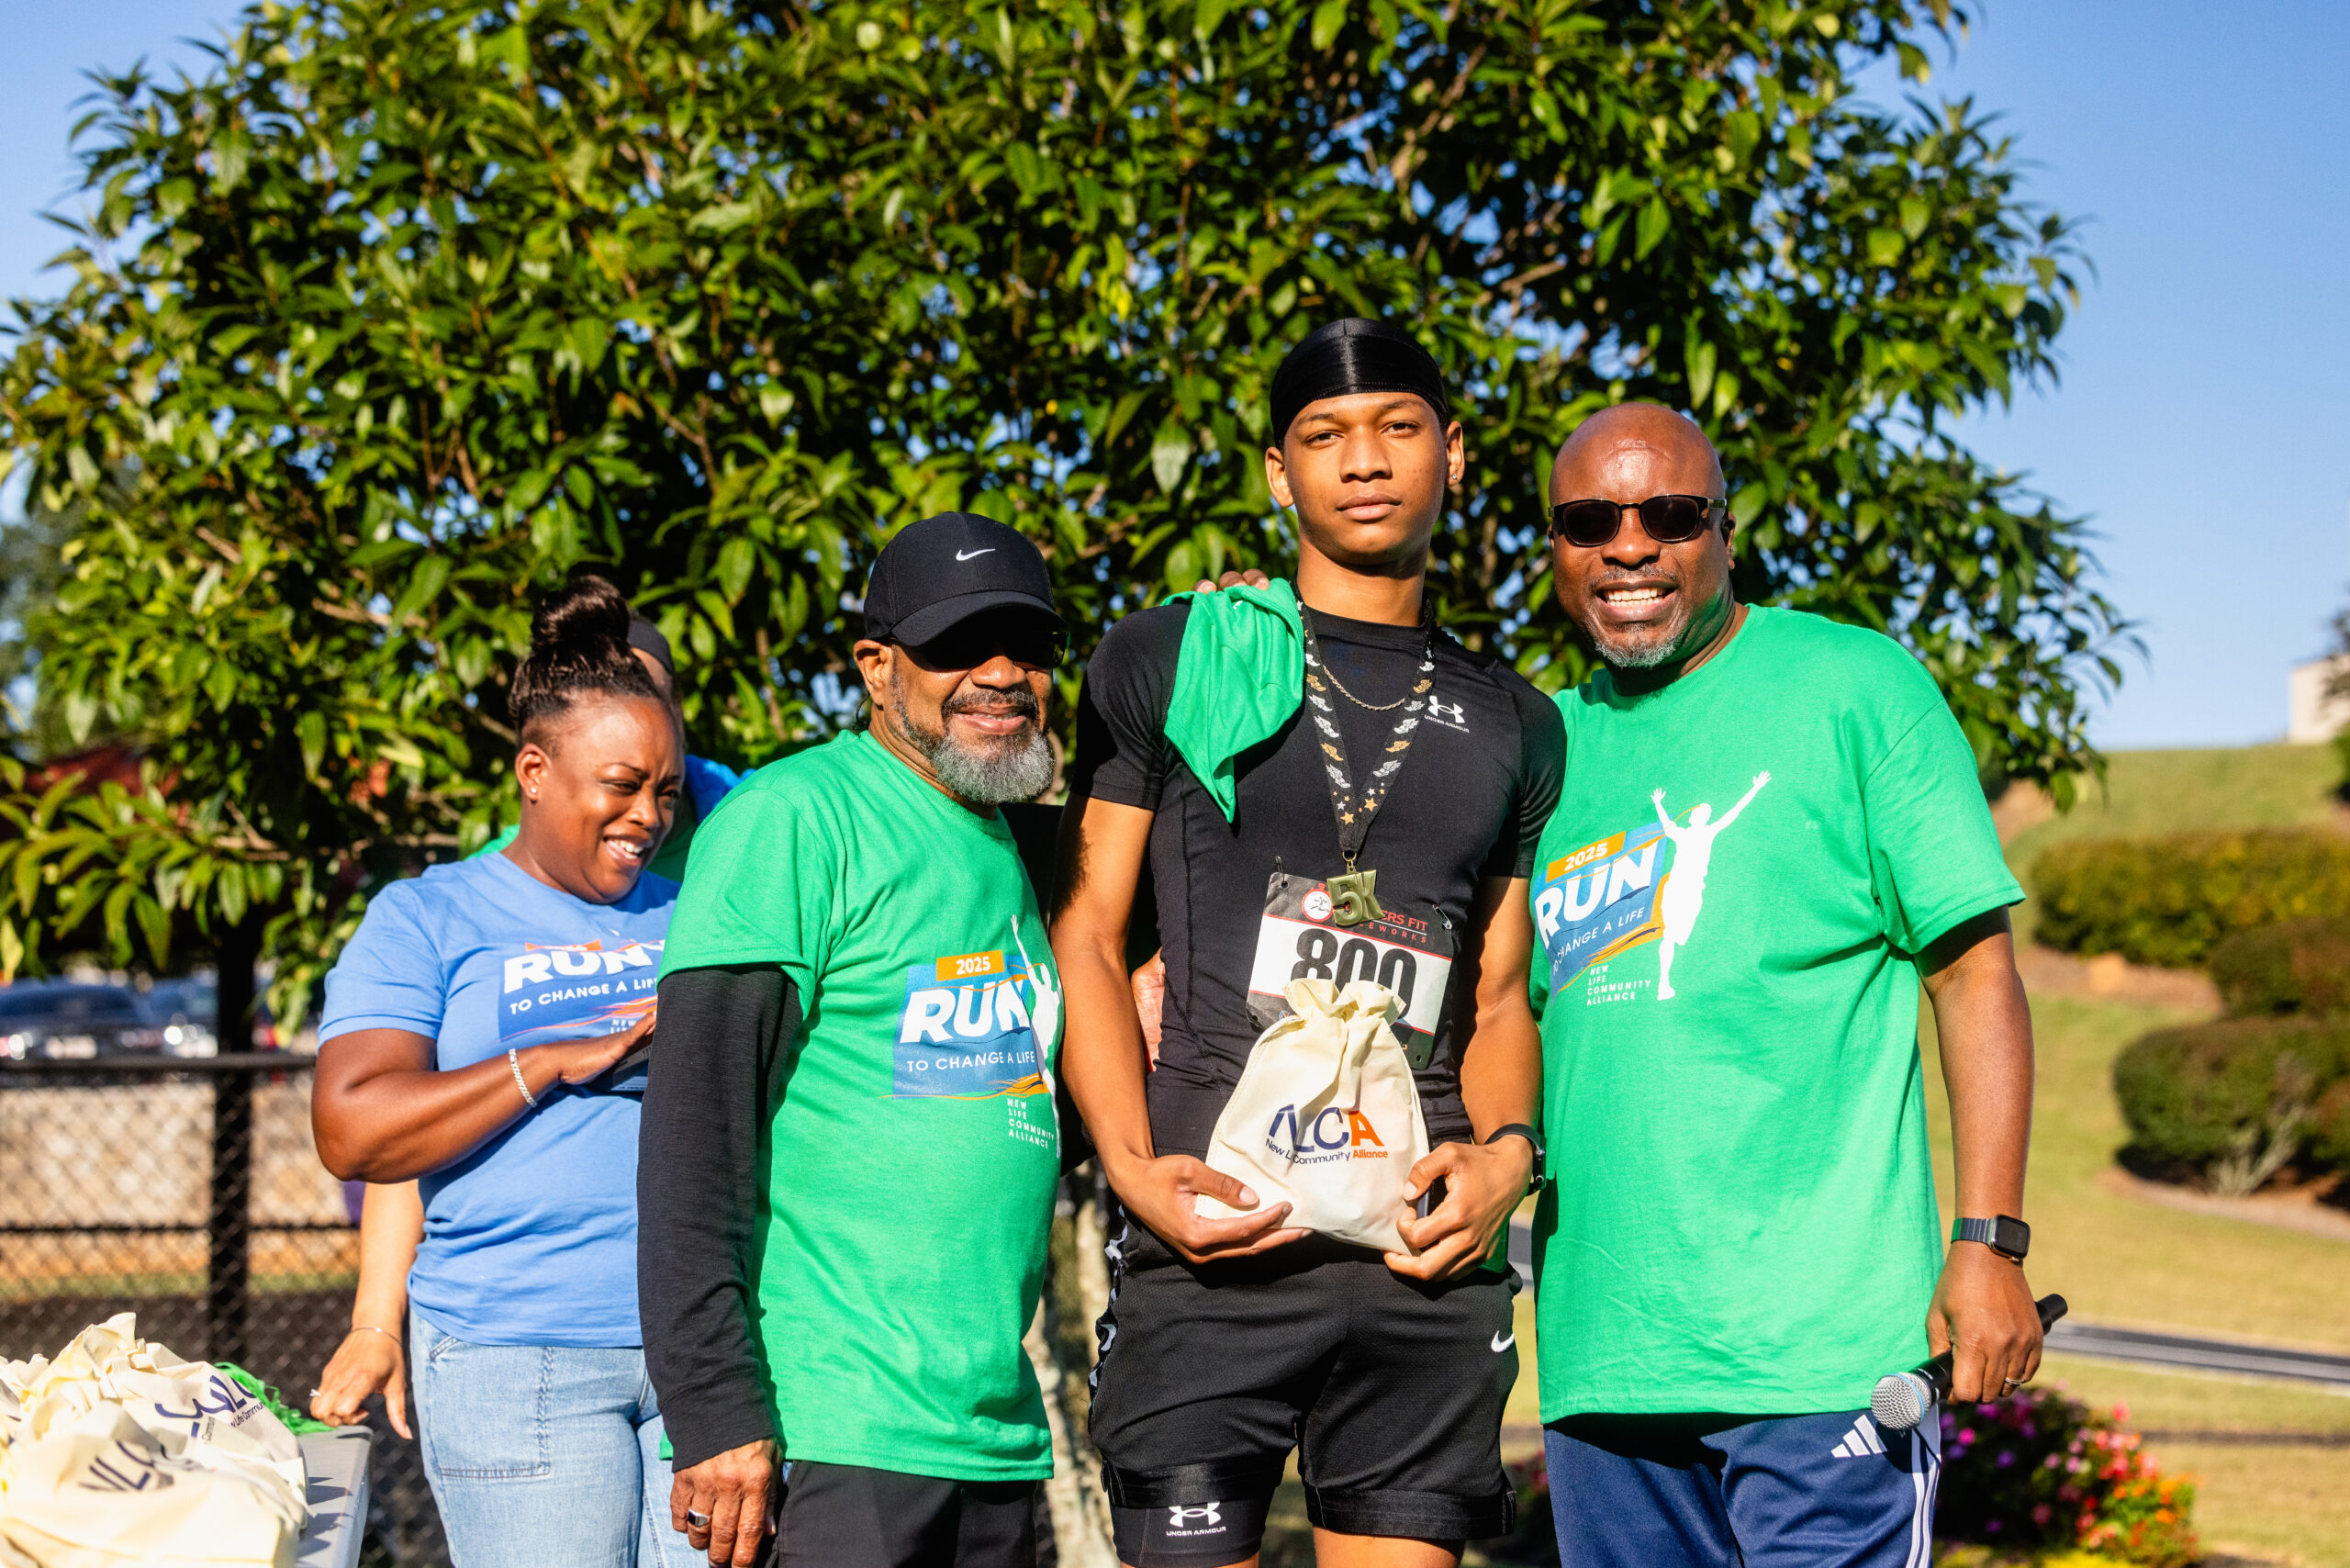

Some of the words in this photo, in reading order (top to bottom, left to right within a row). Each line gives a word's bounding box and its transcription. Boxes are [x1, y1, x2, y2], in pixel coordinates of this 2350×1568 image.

[1424, 714, 1445, 725] UNDER
[1445, 722, 1470, 734] ARMOUR
[1563, 842, 1608, 872] 2025
[1326, 868, 1385, 926] 5K
[1534, 839, 1659, 950] RUN
[1360, 922, 1427, 945] EWORKS
[1407, 916, 1428, 932] FIT
[1557, 926, 1599, 966] CHANGE
[1602, 921, 1613, 935] A
[1617, 906, 1645, 928] LIFE
[504, 946, 654, 994] RUN
[956, 956, 991, 976] 2025
[1290, 927, 1417, 1019] 800
[1590, 964, 1609, 976] NEW
[1586, 979, 1651, 996] COMMUNITY
[1588, 975, 1606, 987] LIFE
[509, 999, 532, 1015] TO
[538, 983, 610, 1005] CHANGE
[615, 980, 628, 993] A
[1586, 991, 1636, 1006] ALLIANCE
[900, 980, 1031, 1044] RUN
[907, 1058, 929, 1073] TO
[935, 1051, 1004, 1070] CHANGE
[1007, 1050, 1014, 1064] A
[1015, 1050, 1036, 1064] LIFE
[1007, 1098, 1027, 1110] NEW
[1008, 1108, 1027, 1120] LIFE
[1008, 1118, 1055, 1141] COMMUNITY
[1008, 1128, 1048, 1149] ALLIANCE
[1265, 1137, 1285, 1157] New
[1292, 1150, 1351, 1165] Community
[1352, 1149, 1389, 1159] Alliance
[1193, 1526, 1227, 1536] ARMOUR
